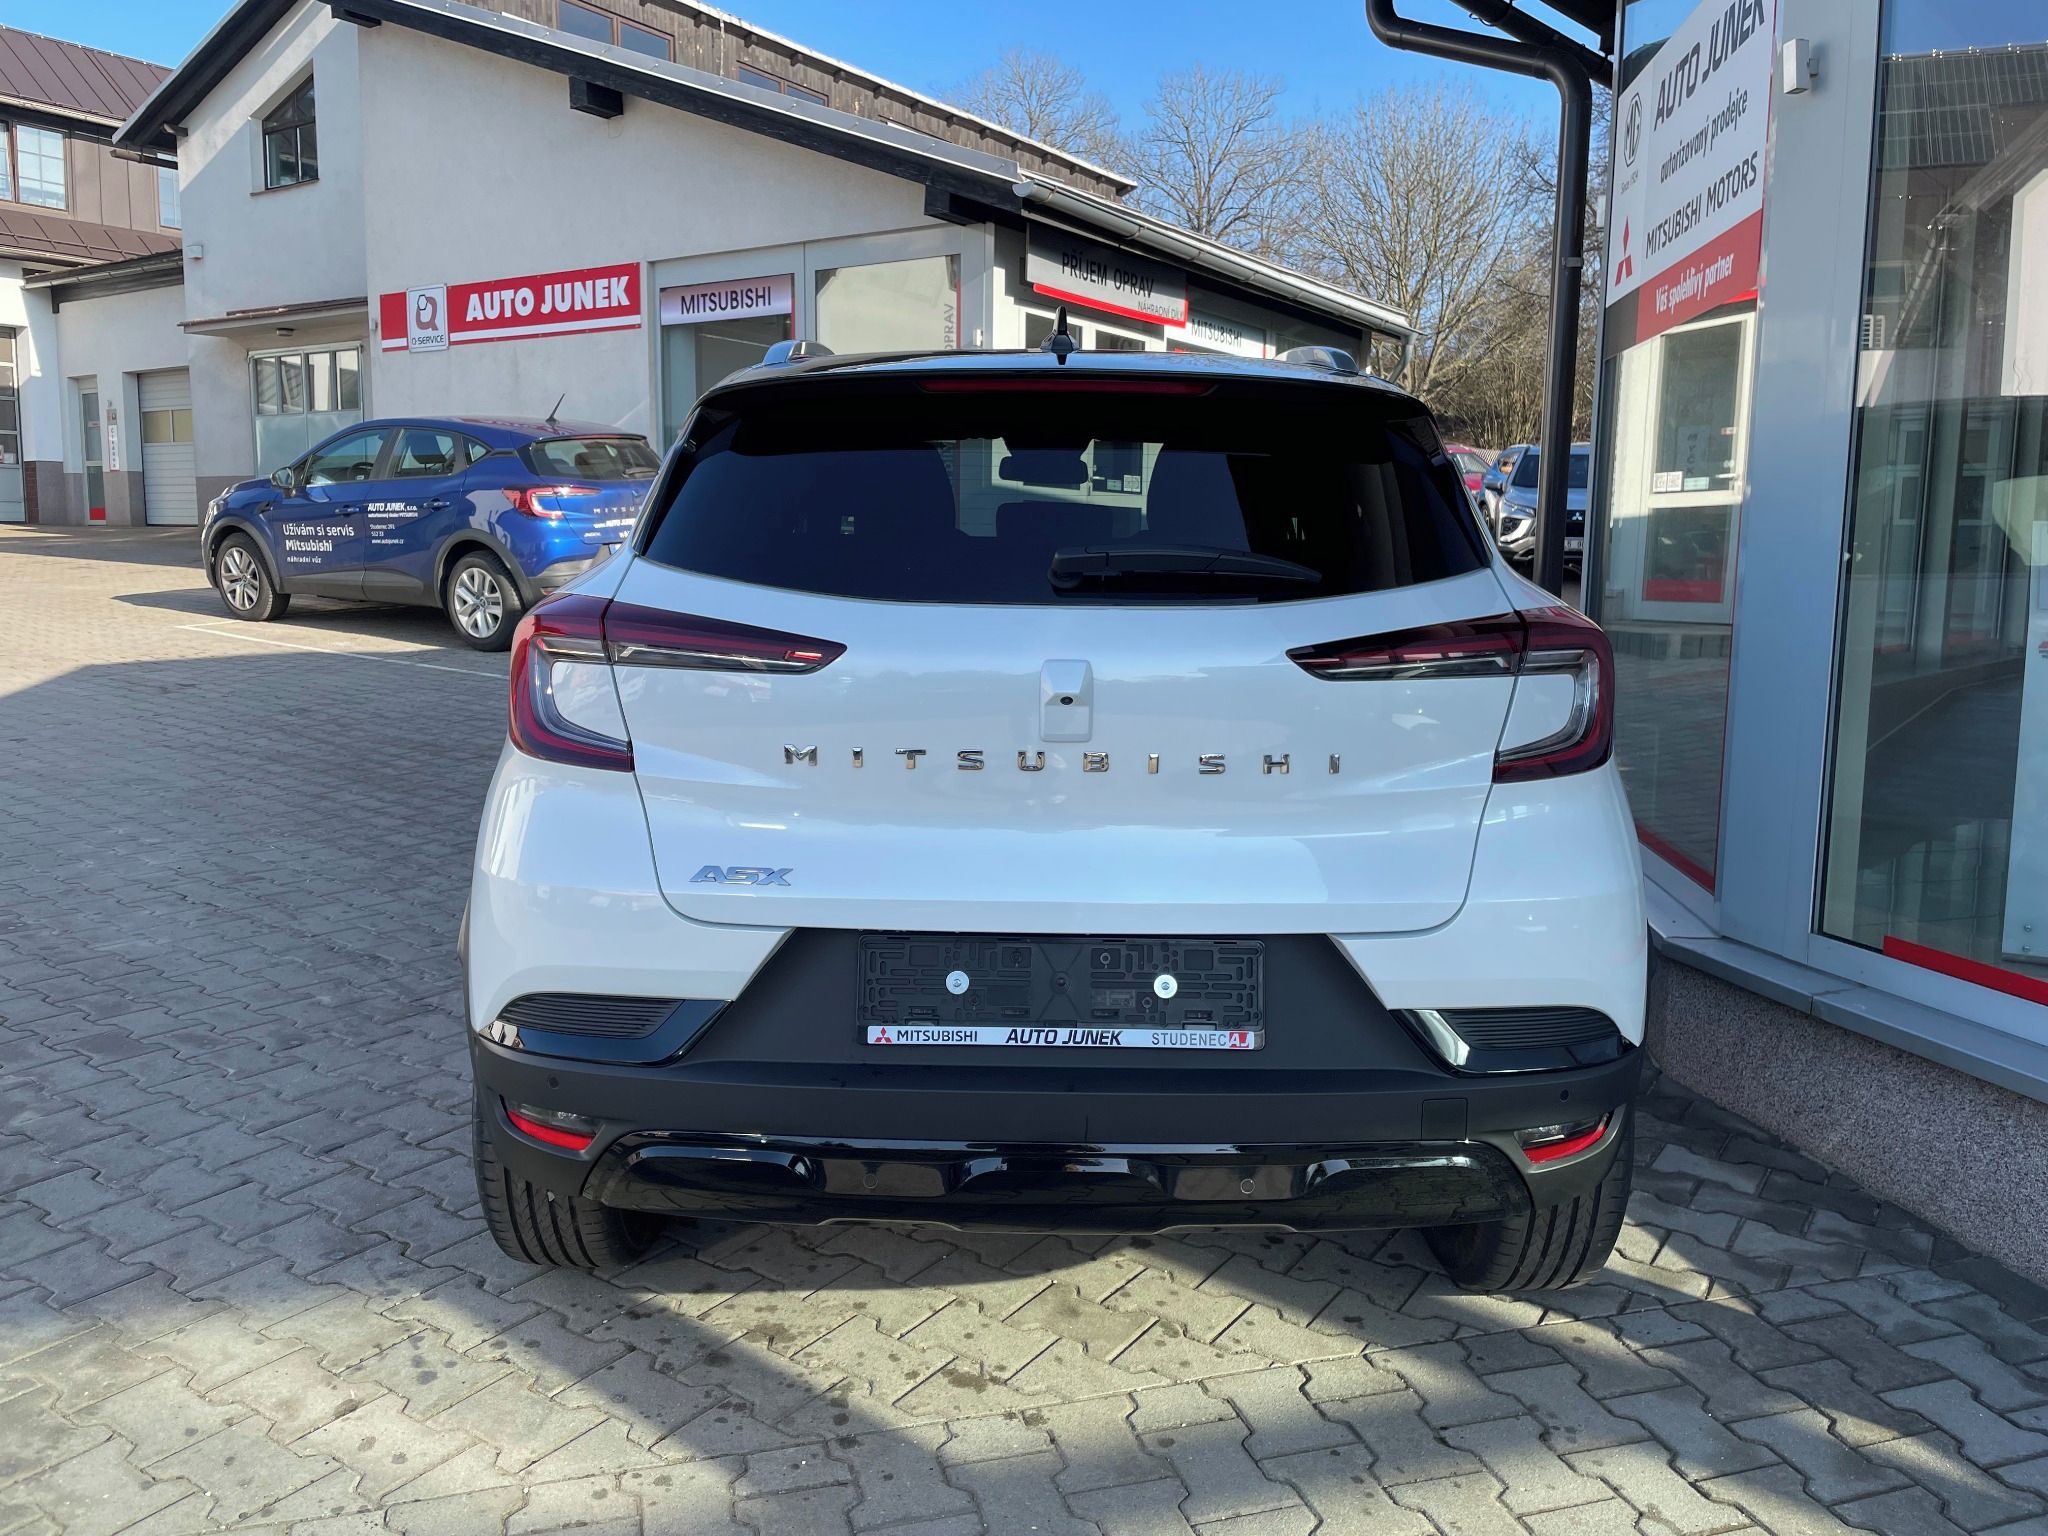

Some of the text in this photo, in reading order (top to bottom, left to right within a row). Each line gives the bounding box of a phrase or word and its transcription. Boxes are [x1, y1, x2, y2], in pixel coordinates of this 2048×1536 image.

[1653, 41, 1701, 132] AUTO
[1660, 87, 1748, 185] autorizovaný prodejce
[1646, 151, 1758, 259] MITSUBISHI MOTORS
[1062, 252, 1155, 299] PŘÍJEM OPRAV
[1656, 252, 1734, 314] Váš spolehlivý partner
[466, 275, 630, 323] AUTO JUNEK
[680, 285, 772, 315] MITSUBISHI
[1191, 318, 1242, 348] MITSUBISHI
[368, 502, 384, 511] AUTO
[283, 523, 355, 537] Užívám si servis
[285, 539, 333, 552] Mitsubishi
[286, 555, 311, 563] náhradní
[783, 743, 1341, 775] MITSUBISHI
[689, 864, 794, 887] ASX
[896, 1029, 978, 1043] MITSUBISHI
[1005, 1029, 1058, 1045] AUTO
[1062, 1030, 1124, 1046] JUNEK
[1151, 1032, 1228, 1047] STUDENEC
